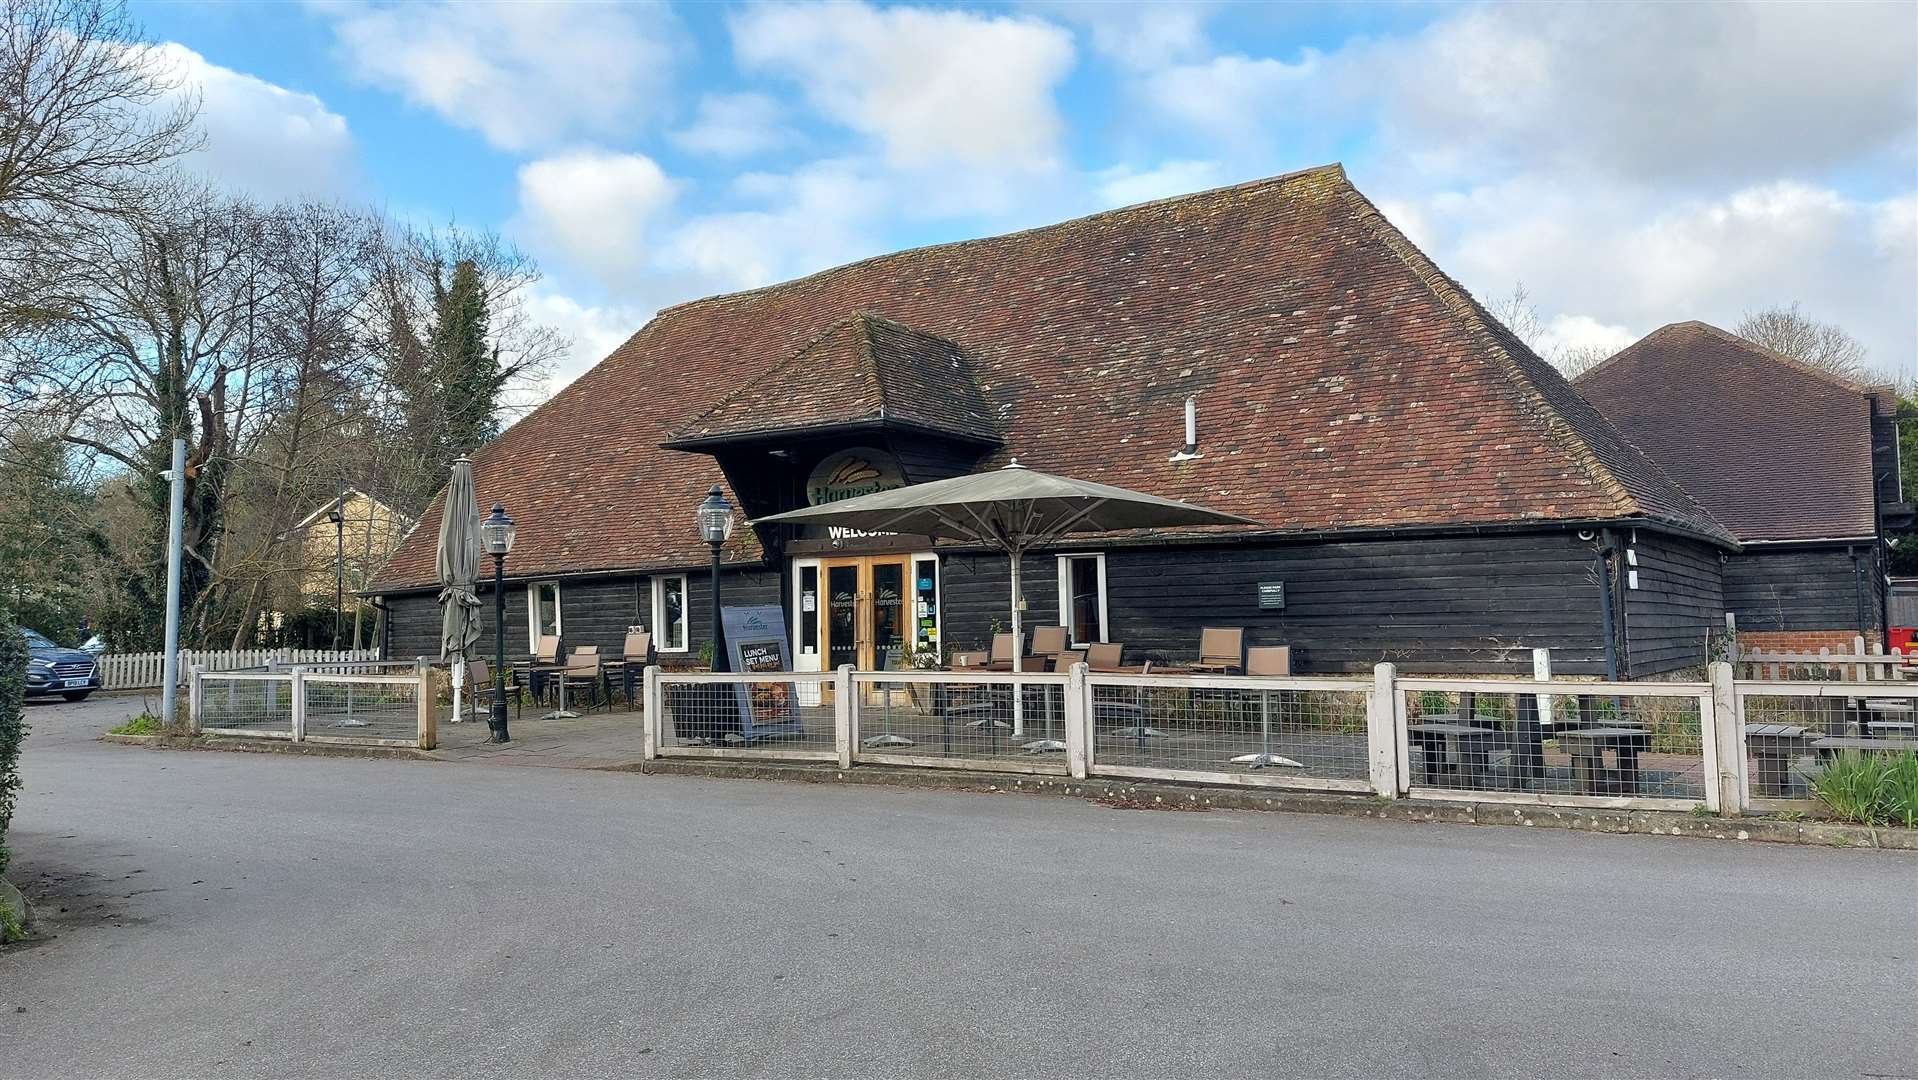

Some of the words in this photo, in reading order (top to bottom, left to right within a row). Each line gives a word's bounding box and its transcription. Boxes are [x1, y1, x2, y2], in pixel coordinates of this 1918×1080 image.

[815, 481, 900, 505] Harvest
[828, 526, 898, 539] WELC
[830, 600, 855, 608] Harvest
[876, 598, 903, 607] Harveste
[744, 648, 767, 657] LUNCH
[745, 657, 758, 666] SET
[759, 654, 779, 664] MENU
